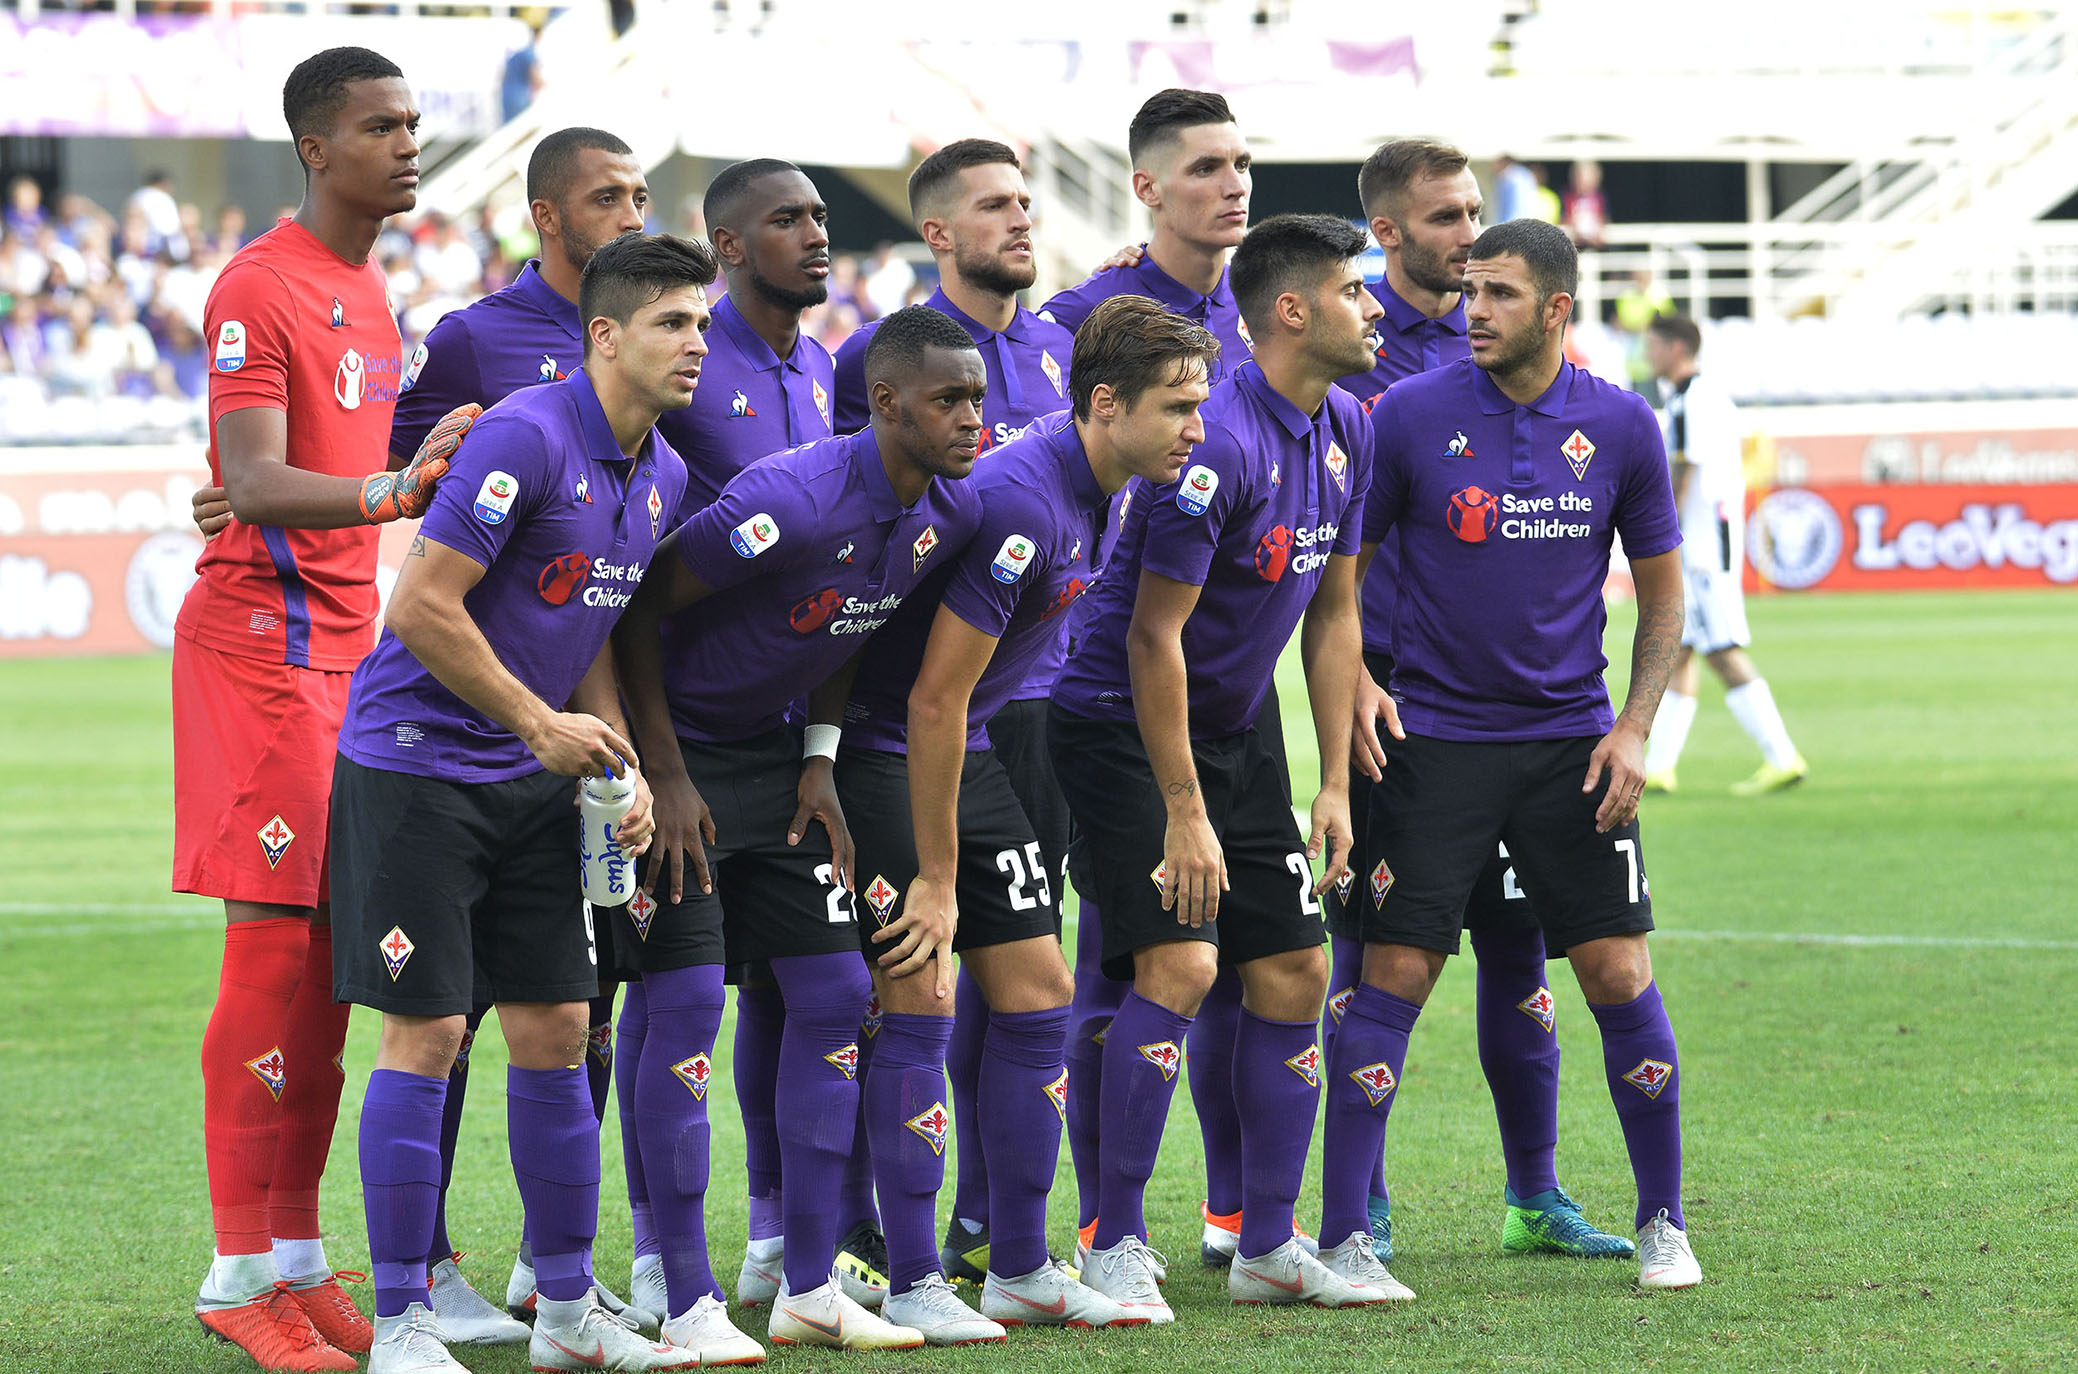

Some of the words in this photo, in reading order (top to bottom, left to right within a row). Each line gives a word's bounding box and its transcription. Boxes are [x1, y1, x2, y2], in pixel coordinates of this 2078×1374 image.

[366, 381, 399, 402] Childre
[1187, 501, 1201, 513] TIM
[1501, 493, 1554, 514] Save
[1558, 491, 1592, 512] the
[486, 510, 500, 522] TIM
[1501, 518, 1591, 540] Children
[738, 541, 751, 555] TIM
[591, 557, 625, 581] Save
[1002, 570, 1015, 582] TIM
[582, 586, 632, 608] Childre
[841, 596, 879, 615] Save
[878, 593, 903, 610] the
[829, 618, 887, 636] Childre
[996, 840, 1052, 912] 25
